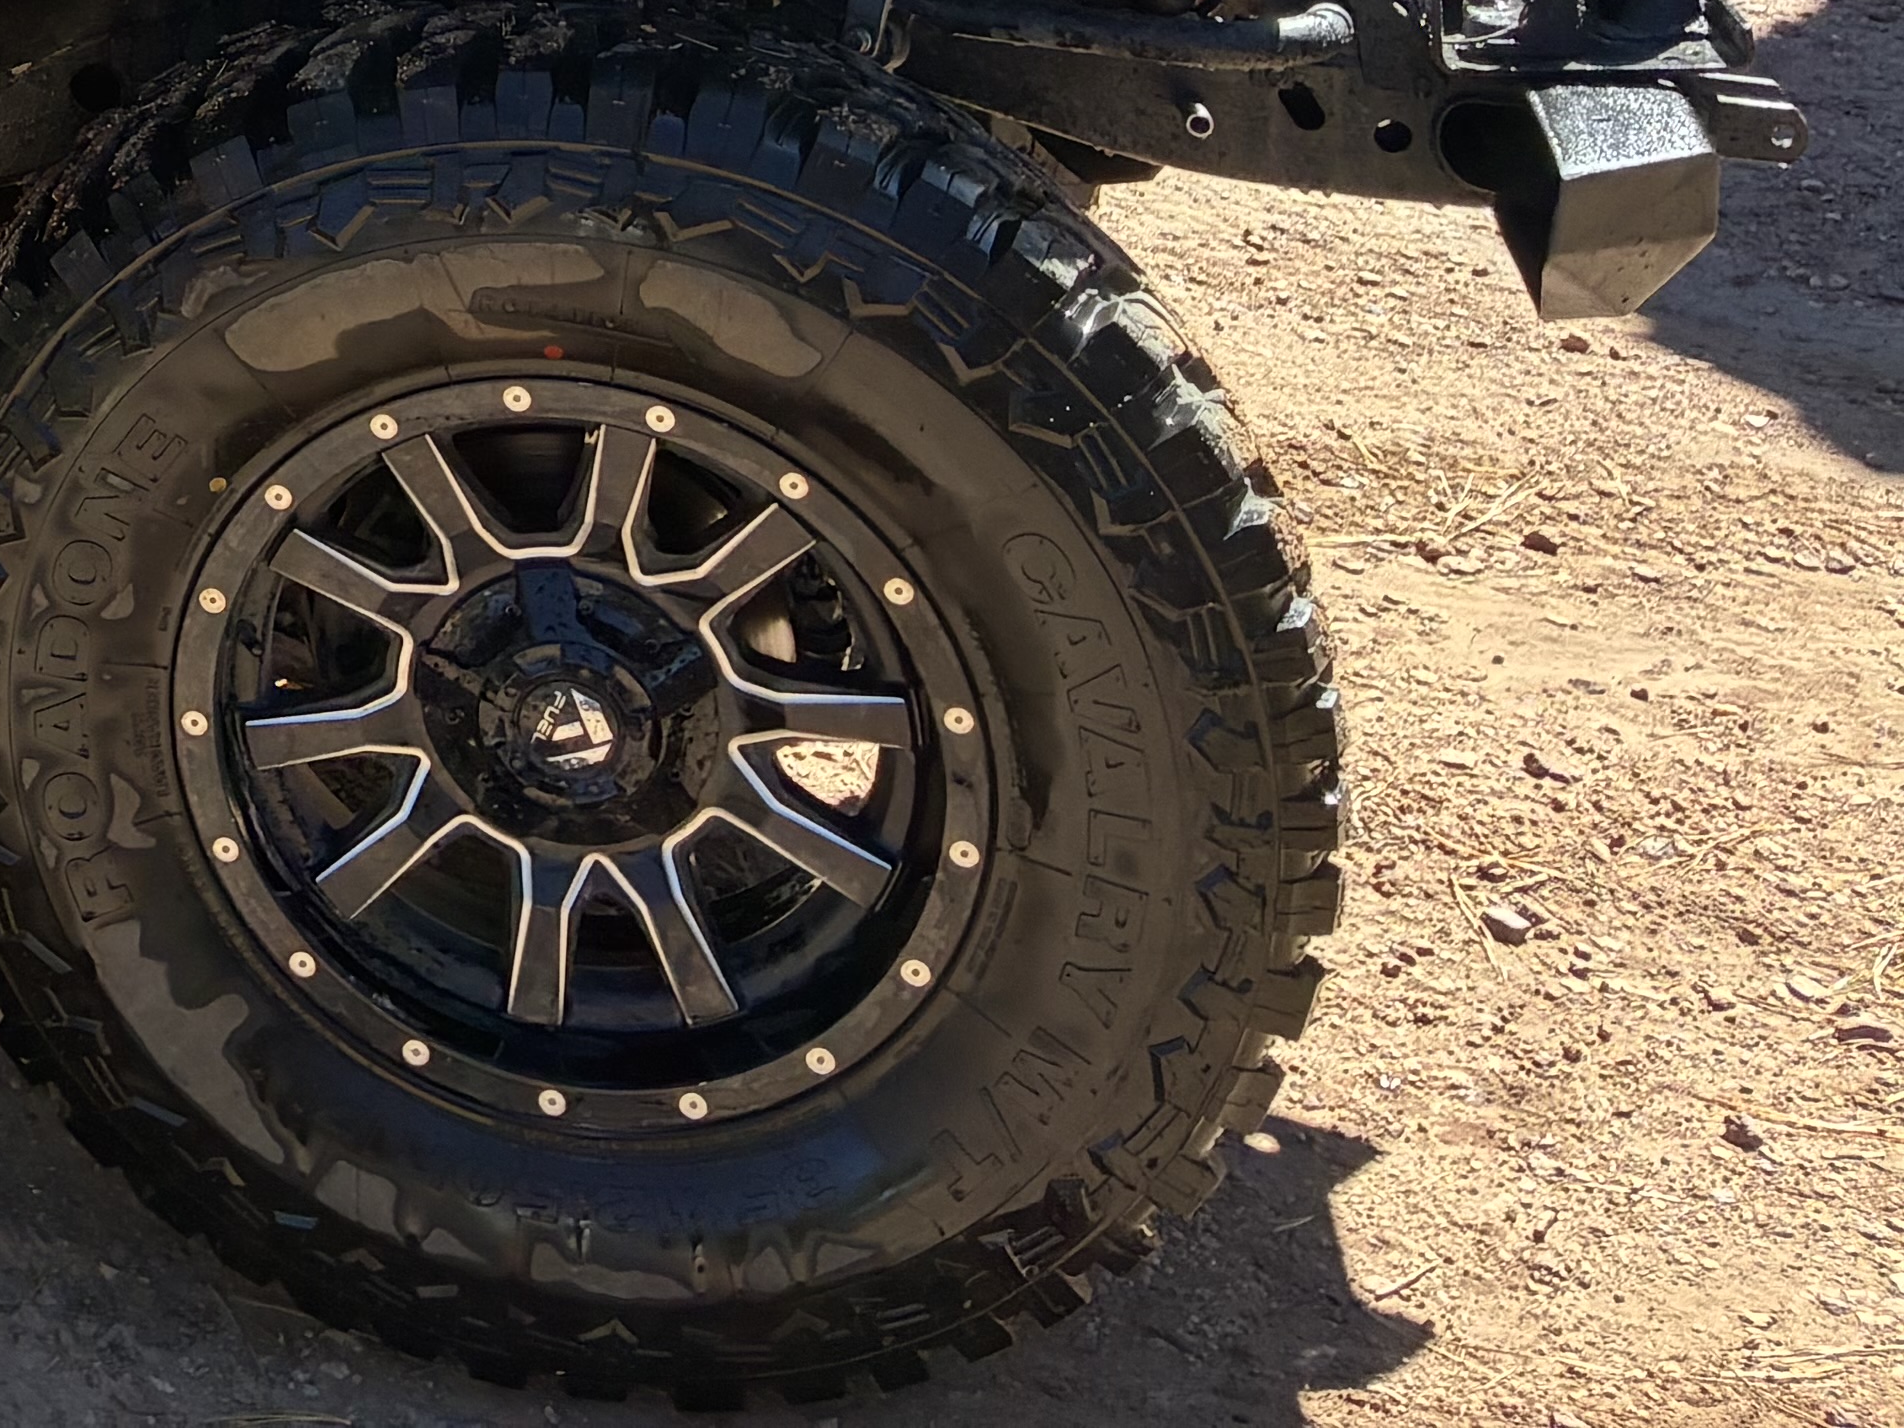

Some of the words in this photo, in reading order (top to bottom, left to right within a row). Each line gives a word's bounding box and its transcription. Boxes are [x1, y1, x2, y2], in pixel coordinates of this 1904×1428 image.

[34, 412, 189, 922] ROADONE
[530, 690, 567, 743] FUEL
[1002, 532, 1152, 1030] CAVALRY
